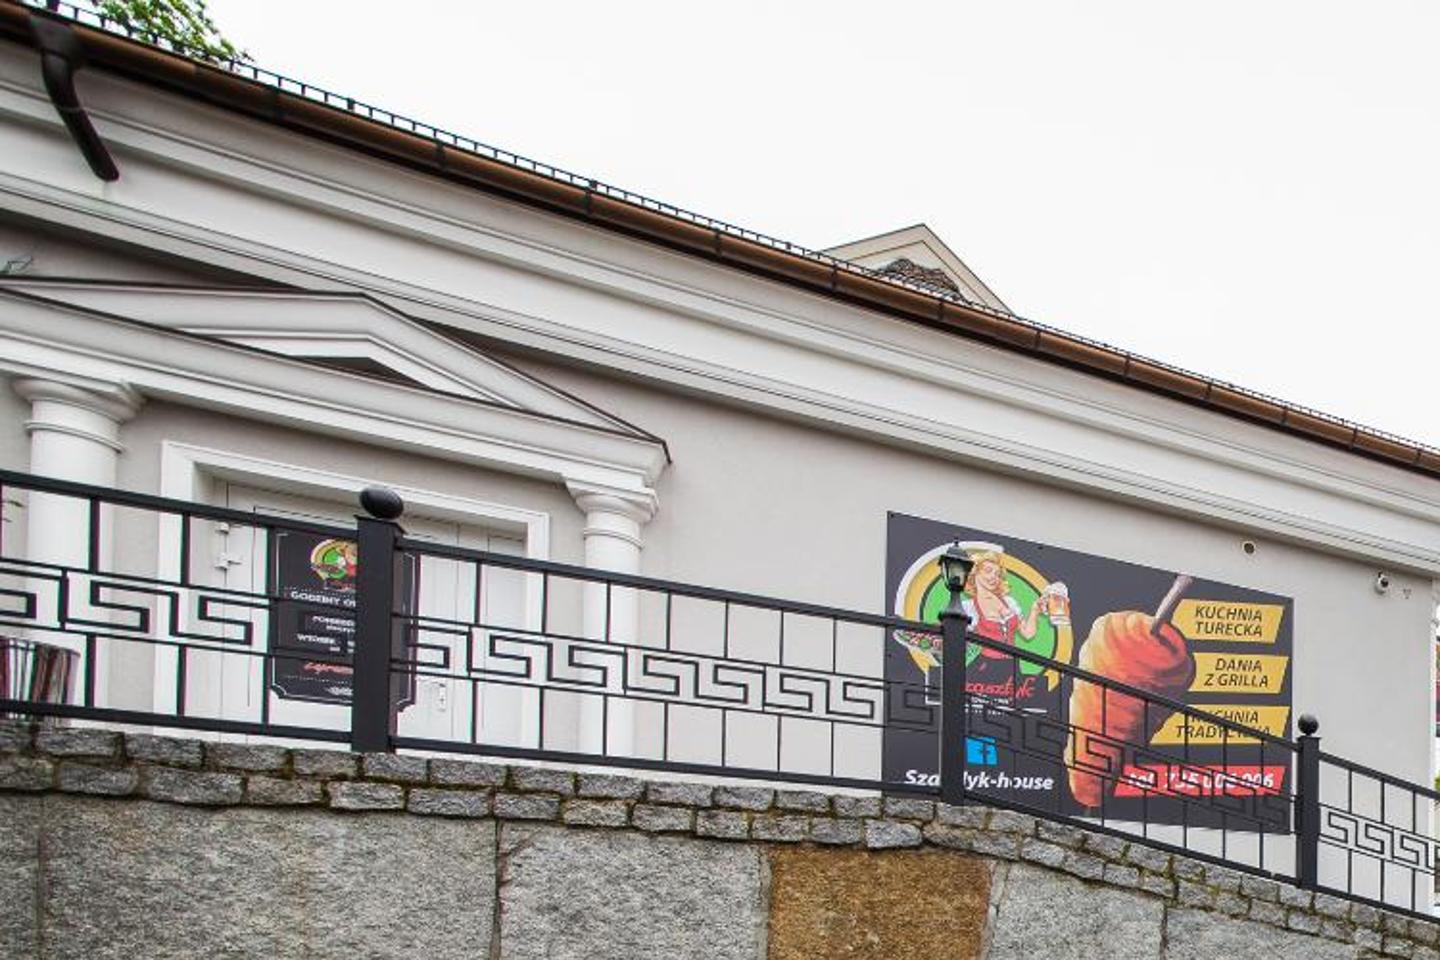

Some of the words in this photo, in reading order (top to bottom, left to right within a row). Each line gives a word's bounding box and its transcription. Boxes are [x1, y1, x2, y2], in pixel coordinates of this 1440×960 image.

[1195, 606, 1262, 622] KUCHNIA
[1195, 621, 1262, 637] TURECKA
[1215, 658, 1263, 673] DANIA
[1204, 673, 1215, 687] Z
[1217, 673, 1269, 688] GRILLA
